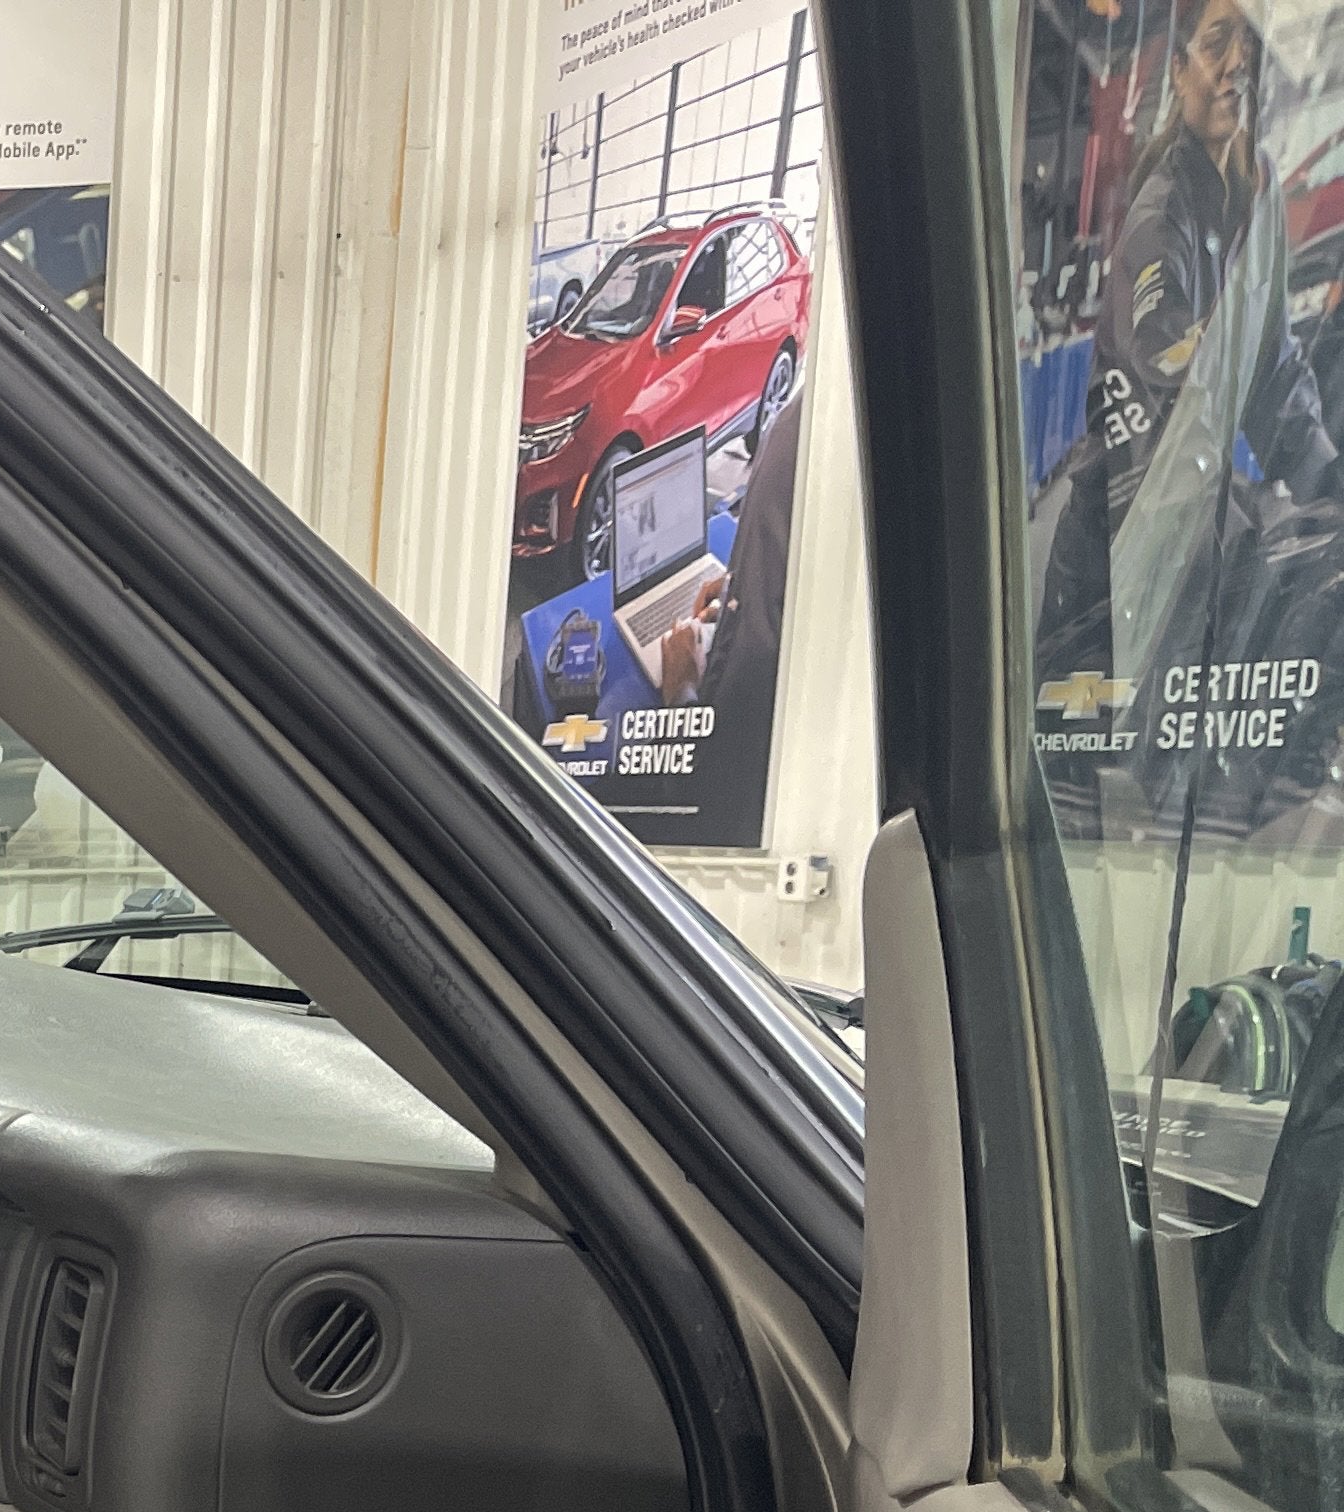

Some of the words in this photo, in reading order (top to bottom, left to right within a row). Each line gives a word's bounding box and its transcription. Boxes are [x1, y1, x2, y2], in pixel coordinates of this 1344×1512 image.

[580, 20, 609, 48] peace
[611, 9, 625, 31] of
[627, 20, 660, 49] health
[662, 0, 706, 34] checked
[4, 120, 63, 136] remote
[1165, 658, 1320, 704] CERTIFIED
[621, 706, 715, 740] CERTIFIED
[1033, 732, 1139, 752] CHEVROLET
[557, 760, 609, 776] VROLET
[618, 743, 696, 776] SERVICE
